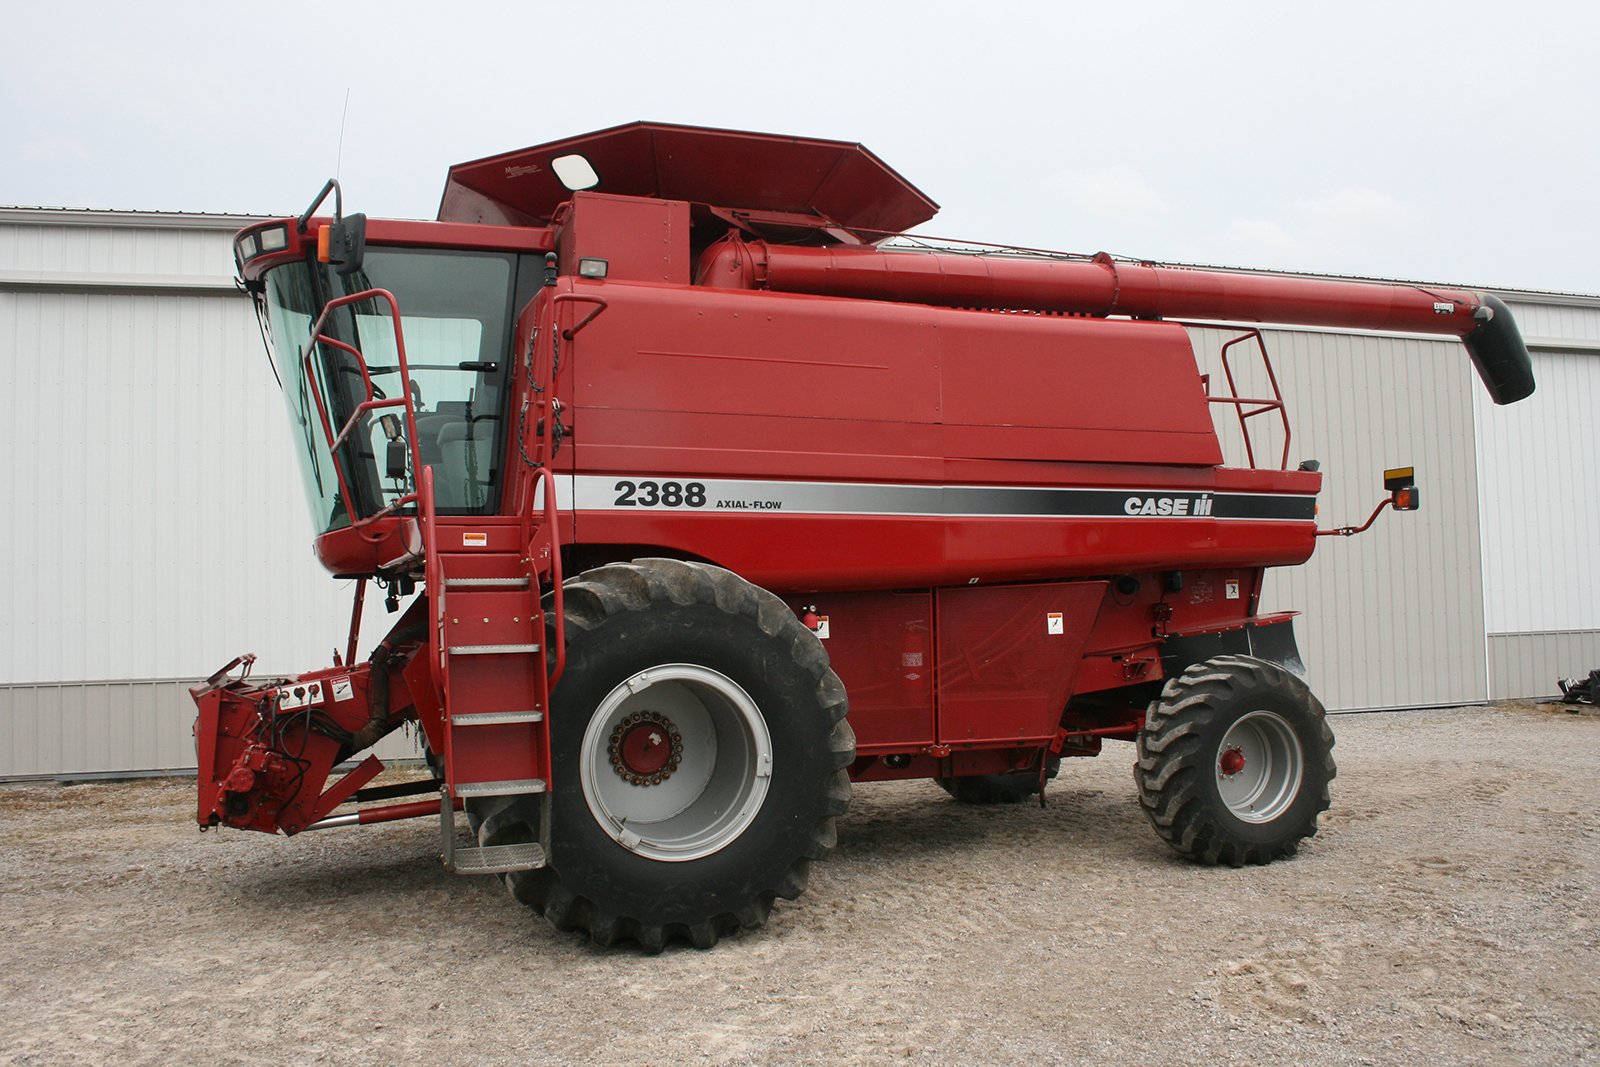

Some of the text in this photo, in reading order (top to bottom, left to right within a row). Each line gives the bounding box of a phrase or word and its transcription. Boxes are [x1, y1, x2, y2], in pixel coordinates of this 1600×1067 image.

[614, 480, 707, 508] 2388
[716, 500, 782, 510] AXIAL-FLOW
[1124, 497, 1189, 516] CASE
